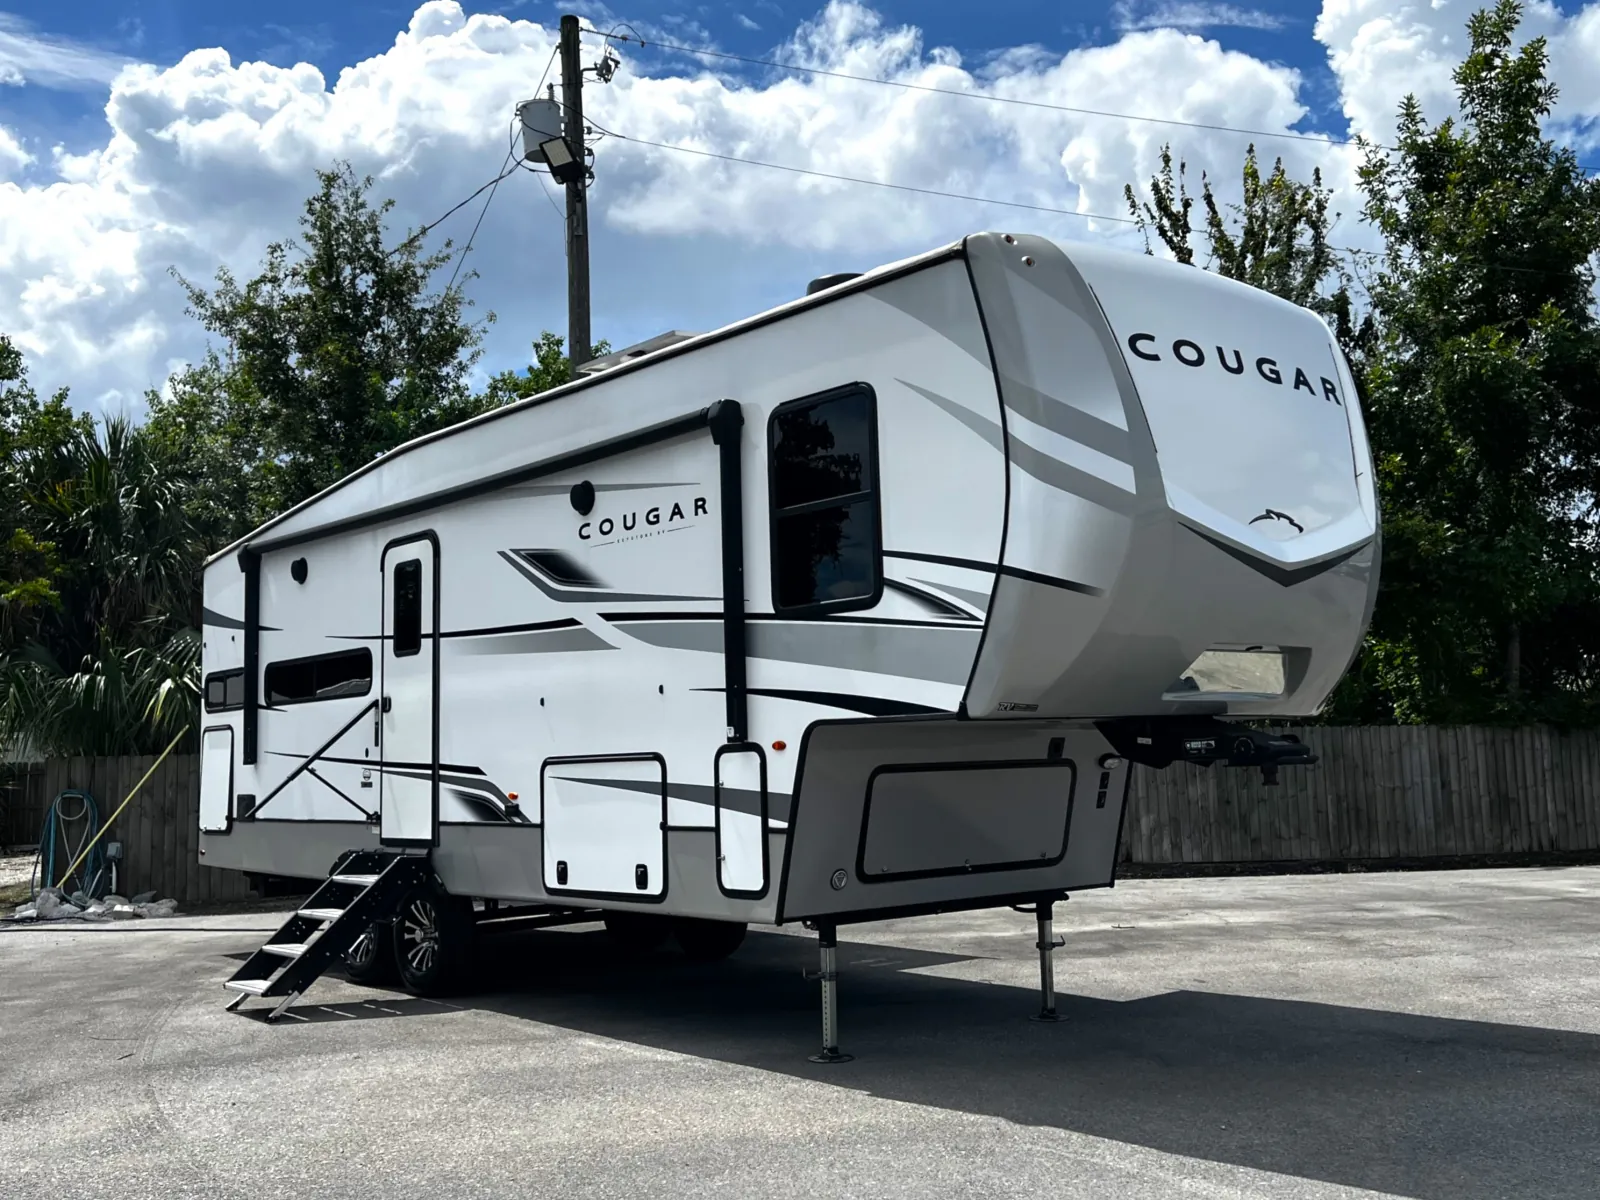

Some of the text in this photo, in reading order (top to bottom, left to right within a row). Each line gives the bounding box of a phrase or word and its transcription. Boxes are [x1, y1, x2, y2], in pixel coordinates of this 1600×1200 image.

[1128, 333, 1342, 406] COUGAR
[578, 497, 708, 540] COUGAR
[998, 702, 1014, 711] RV
